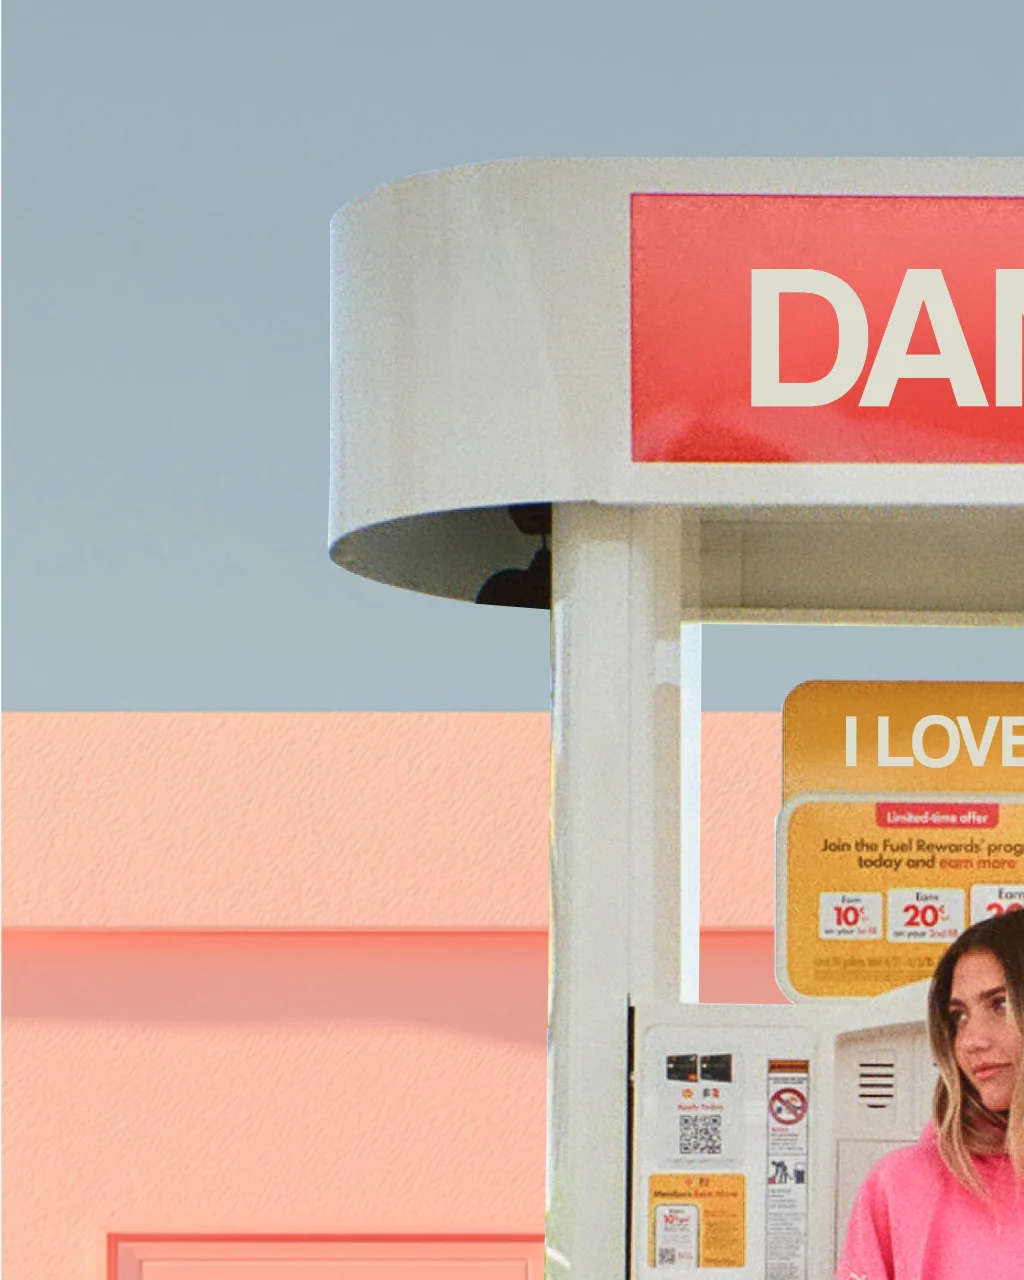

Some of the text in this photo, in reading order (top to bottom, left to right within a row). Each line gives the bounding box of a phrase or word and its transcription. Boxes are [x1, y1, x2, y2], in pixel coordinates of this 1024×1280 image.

[845, 716, 857, 767] I
[886, 812, 988, 824] Limited-time offer
[821, 838, 851, 853] Join
[855, 839, 878, 853] the
[883, 839, 912, 853] Fuel
[858, 856, 1017, 871] today and earn more
